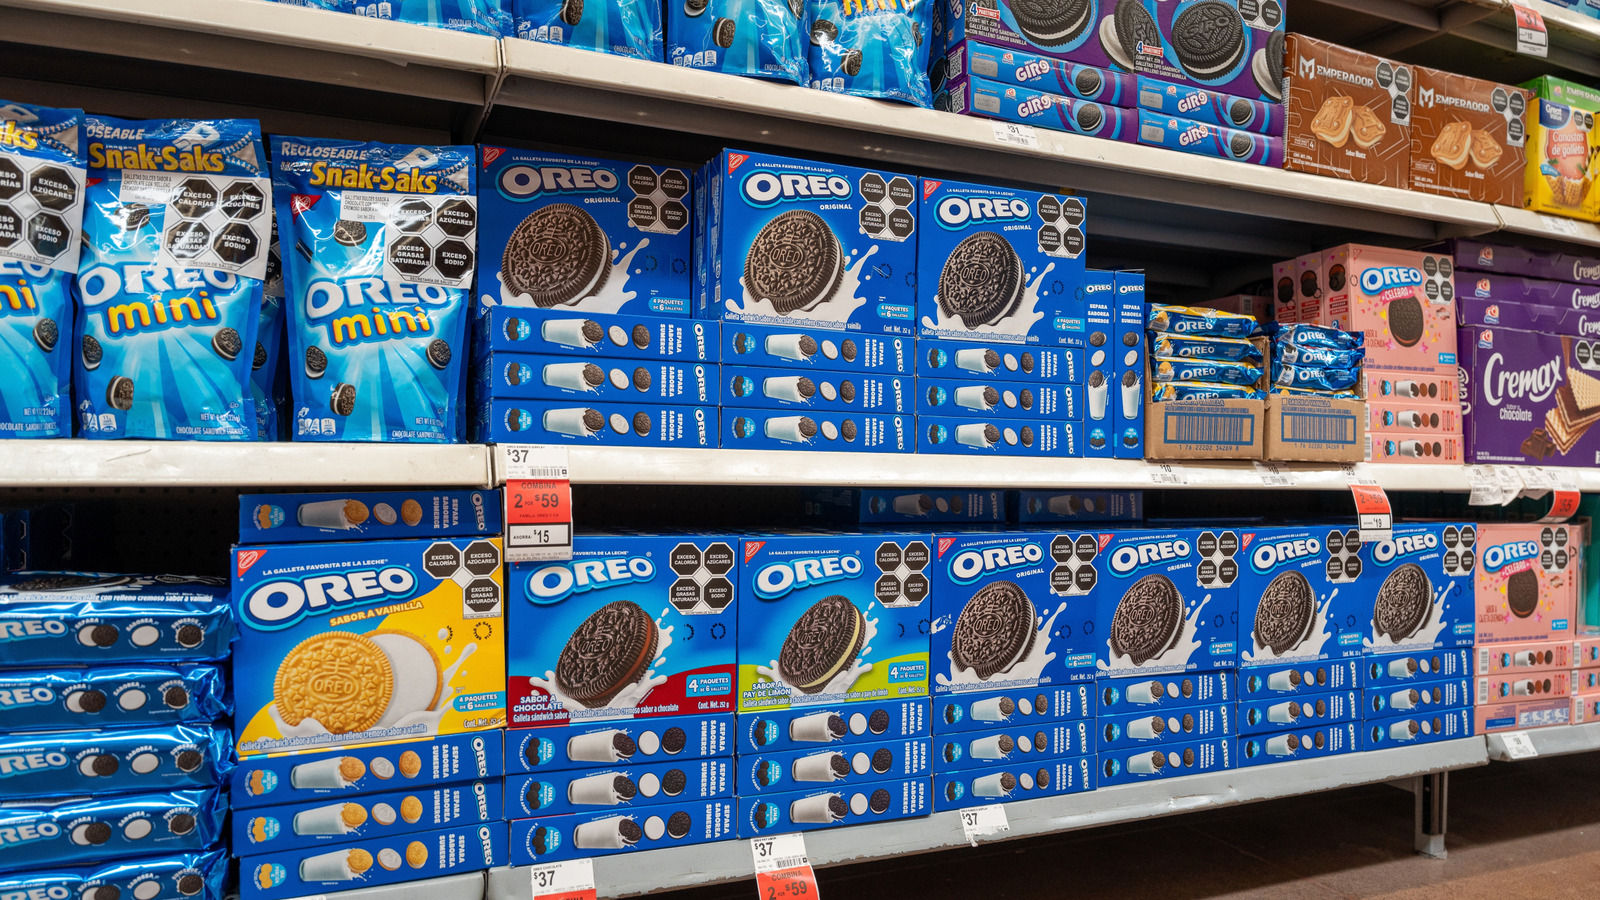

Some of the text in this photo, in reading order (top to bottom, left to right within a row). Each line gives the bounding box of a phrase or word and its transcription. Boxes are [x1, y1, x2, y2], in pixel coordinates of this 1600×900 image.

[1316, 65, 1374, 87] EMPERADOR
[1435, 94, 1490, 113] EMPERADOR
[1546, 104, 1562, 115] Great
[1553, 132, 1584, 141] Canastas
[89, 142, 225, 172] Snak-Saks
[281, 142, 367, 160] RECLOSEABLE
[1552, 144, 1584, 156] de galleta
[38, 177, 68, 191] EXCESO
[310, 161, 438, 194] Snak-Saks
[502, 167, 617, 195] OREO
[32, 185, 73, 201] AZÚCARES
[746, 172, 850, 201] OREO
[178, 199, 215, 207] CALORÍAS
[443, 210, 469, 218] EXCESO
[939, 198, 1030, 224] OREO
[439, 217, 473, 226] AZÚCARES
[222, 234, 250, 244] EXCESO
[224, 241, 247, 250] SODIO
[390, 257, 430, 266] SATURADAS
[79, 265, 237, 306] OREO
[1363, 268, 1421, 291] OREO
[306, 278, 446, 322] OREO
[107, 291, 216, 333] mini
[331, 306, 432, 344] mini
[1175, 320, 1213, 332] OREO
[694, 323, 705, 360] OREO
[1298, 331, 1325, 342] OREO
[894, 338, 903, 372] OREO
[1179, 346, 1214, 357] OREO
[1066, 350, 1074, 381] OREO
[1180, 368, 1216, 380] OREO
[1484, 353, 1562, 406] Cremax
[1500, 408, 1532, 422] Chocolate
[507, 449, 529, 462] $37
[514, 494, 523, 508] 2
[535, 494, 559, 508] $59
[471, 493, 484, 530] OREO
[534, 530, 549, 543] $15
[1254, 538, 1320, 569] OREO
[1375, 533, 1438, 561] OREO
[1485, 542, 1539, 566] OREO
[953, 544, 1042, 578] OREO
[1112, 540, 1190, 571] OREO
[1419, 553, 1439, 561] ORIGINAL
[274, 566, 305, 574] GALLETA
[1167, 563, 1192, 571] ORIGINAL
[1301, 560, 1322, 568] ORIGINAL
[530, 558, 653, 597] OREO
[757, 556, 861, 593] OREO
[1016, 568, 1044, 578] ORIGINAL
[249, 568, 414, 621] OREO
[330, 601, 423, 626] SABOR A VAINILLA
[0, 620, 65, 638] REO
[74, 618, 99, 630] SEPARA
[125, 618, 153, 632] SABOREA
[171, 618, 200, 628] SUMERGE
[890, 668, 898, 678] 4
[688, 679, 698, 692] 4
[768, 688, 791, 696] LIMÓN
[464, 694, 498, 702] PAQUETES
[520, 695, 548, 703] SABOR
[467, 701, 474, 710] 6
[513, 702, 563, 712] CHOCOLATE
[962, 813, 978, 826] $37
[755, 842, 773, 856] $37
[534, 871, 555, 887] $37
[772, 871, 802, 881] COMBINA
[768, 887, 776, 900] 2
[785, 881, 807, 896] $59
